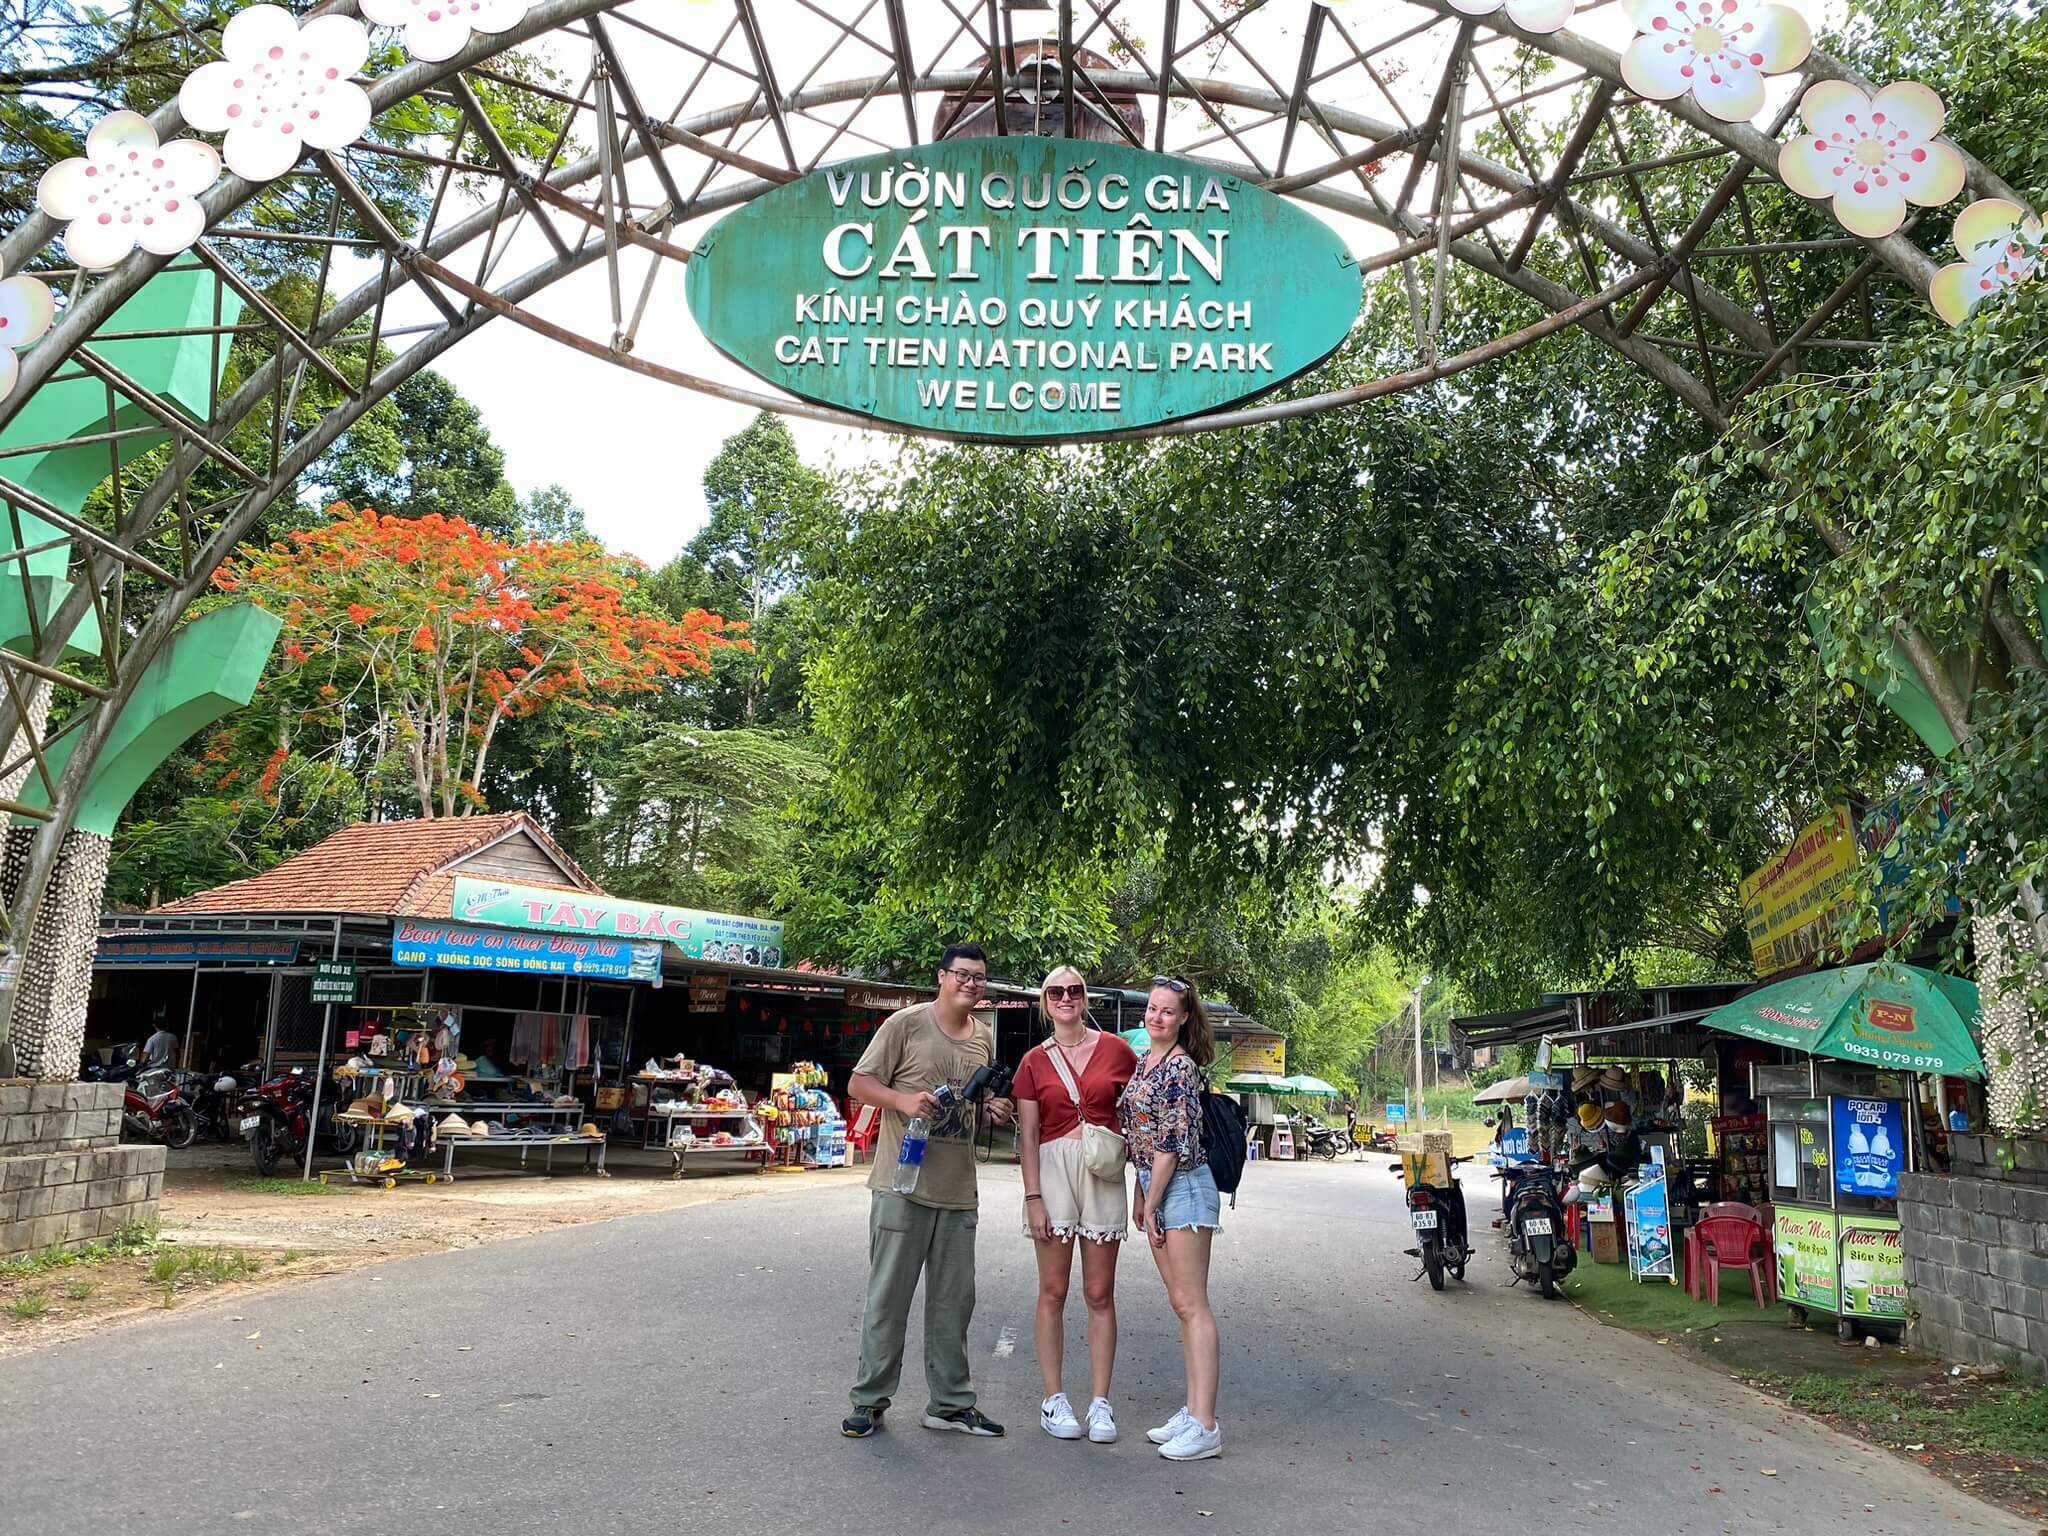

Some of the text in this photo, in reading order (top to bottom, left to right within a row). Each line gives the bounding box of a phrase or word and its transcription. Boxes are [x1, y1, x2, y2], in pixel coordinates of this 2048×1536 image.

[825, 158, 1230, 212] VƯỜN QUỐC GIA
[823, 208, 1230, 284] CÁT TIÊN
[795, 287, 1252, 329] KÍNH CHÀO QUÝ KHÁCH
[774, 335, 1274, 372] CAT TIEN NATIONAL PARK
[916, 379, 1121, 411] WELCOME
[1812, 852, 1834, 876] products
[522, 900, 692, 939] TÂY BẮC
[398, 921, 441, 944] Boat
[444, 928, 480, 948] tour
[482, 935, 504, 950] on
[507, 933, 545, 953] river
[397, 950, 426, 962] CANO
[863, 992, 901, 1008] Restaurant
[1876, 1009, 1907, 1022] P-N
[1844, 1042, 1943, 1068] 0933 079 679
[1848, 1100, 1887, 1113] POCARI
